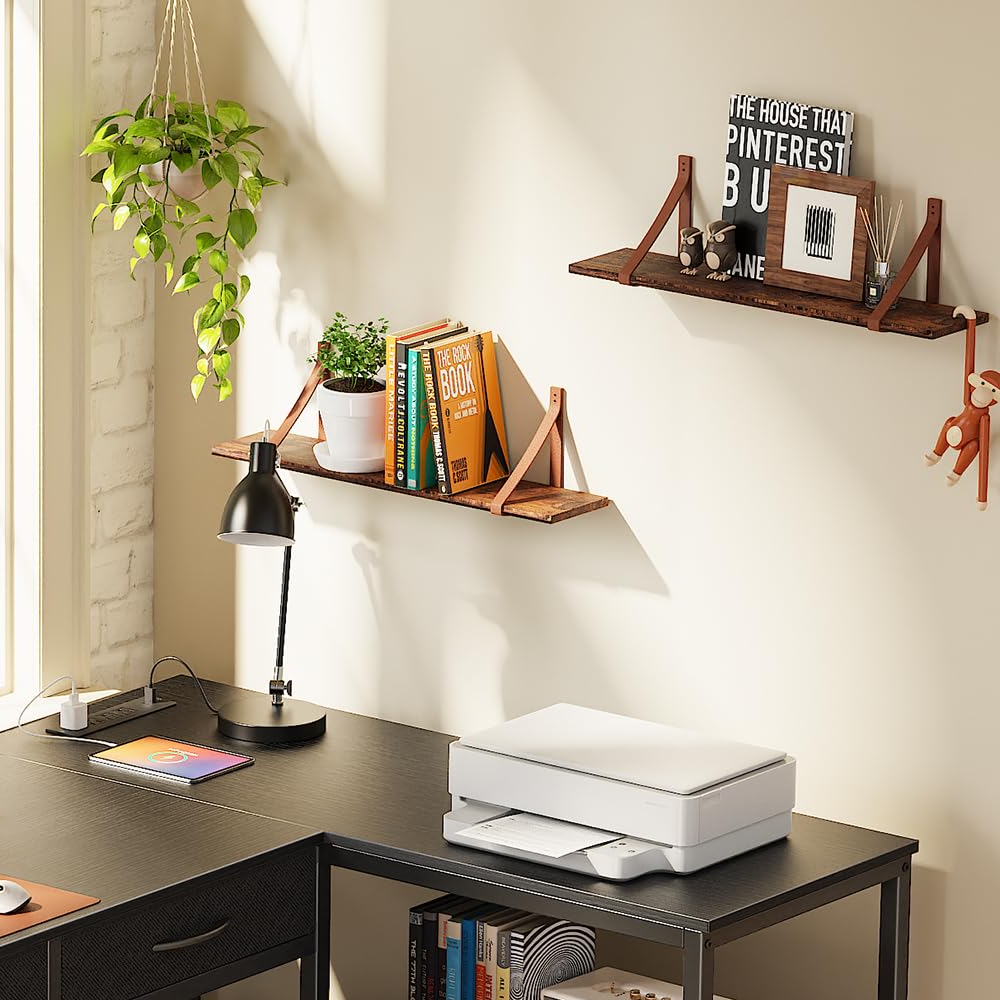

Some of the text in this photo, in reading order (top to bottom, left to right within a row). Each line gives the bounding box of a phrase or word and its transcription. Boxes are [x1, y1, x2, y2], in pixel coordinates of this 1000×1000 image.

[729, 95, 847, 136] THE HOUSE THAT
[726, 124, 845, 176] PINTEREST
[422, 351, 432, 372] THE
[437, 343, 472, 369] THE ROCK
[424, 373, 436, 400] ROCK
[440, 361, 475, 401] BOOK
[397, 362, 407, 470] REVOLT J.COLTRANE
[428, 402, 439, 430] BOOK
